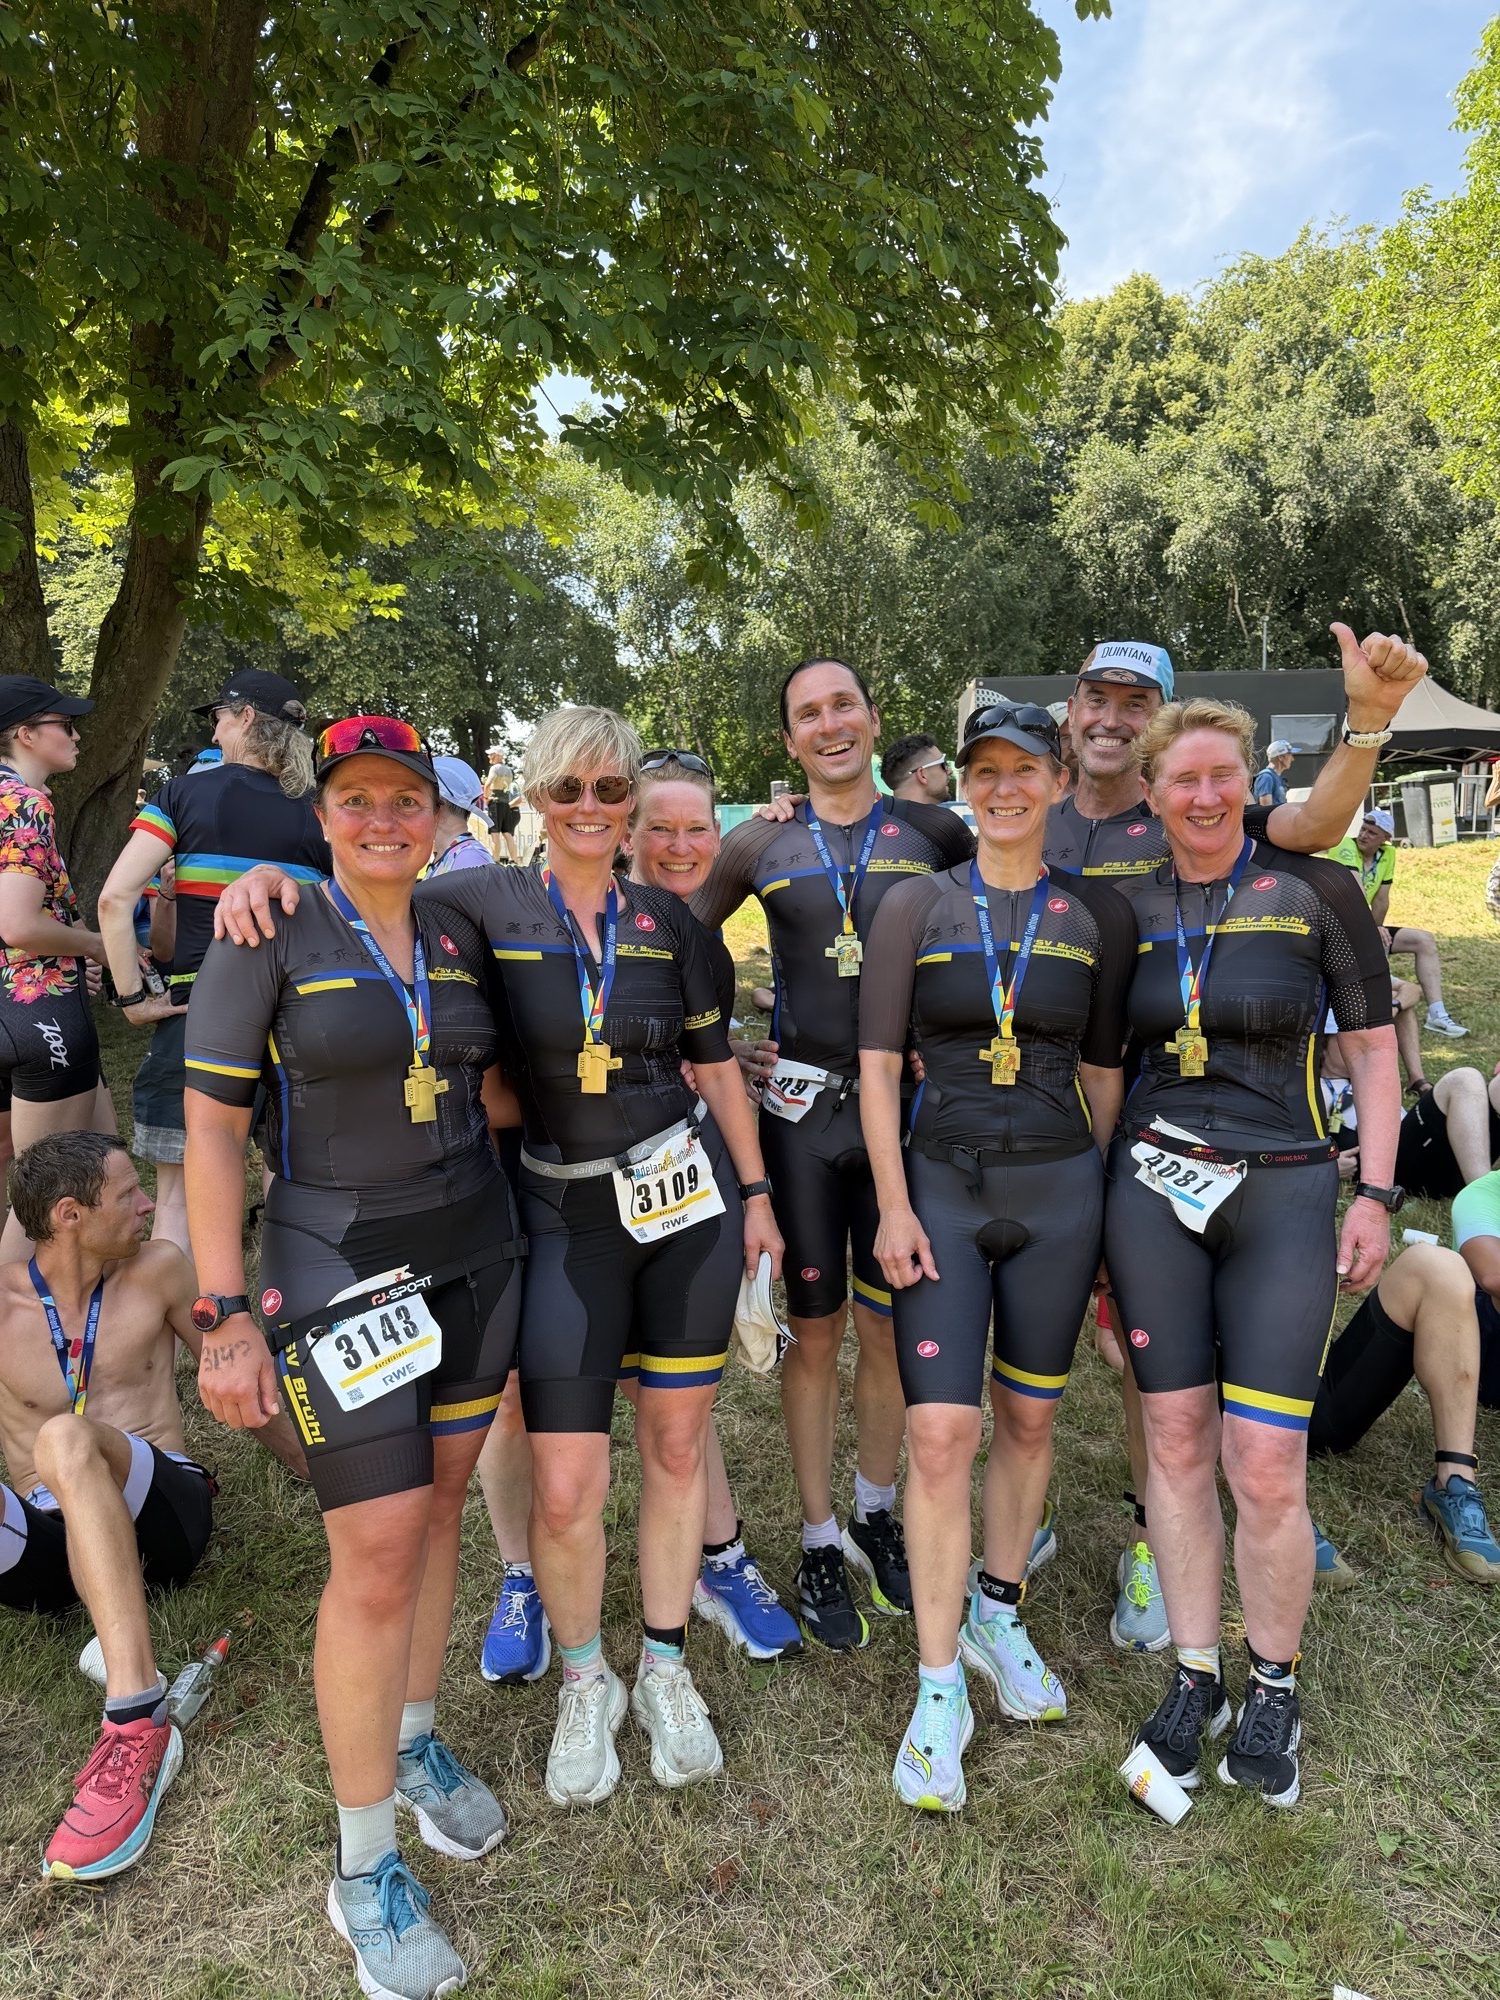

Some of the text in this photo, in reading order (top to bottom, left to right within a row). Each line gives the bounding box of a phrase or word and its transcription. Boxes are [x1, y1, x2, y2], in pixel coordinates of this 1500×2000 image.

[1101, 647, 1152, 666] QUINTANA
[1226, 916, 1255, 924] PSV
[1275, 923, 1304, 931] Team
[1034, 939, 1053, 947] SV
[766, 1098, 782, 1113] RWE
[1182, 1149, 1224, 1162] CARGLASS
[572, 1162, 610, 1176] sailfish
[1144, 1152, 1214, 1195] 4081
[636, 1164, 698, 1214] 3109
[662, 1213, 689, 1231] RWE
[335, 1304, 421, 1371] 3143
[382, 1361, 417, 1386] RWE
[285, 1342, 326, 1443] SV Brühl
